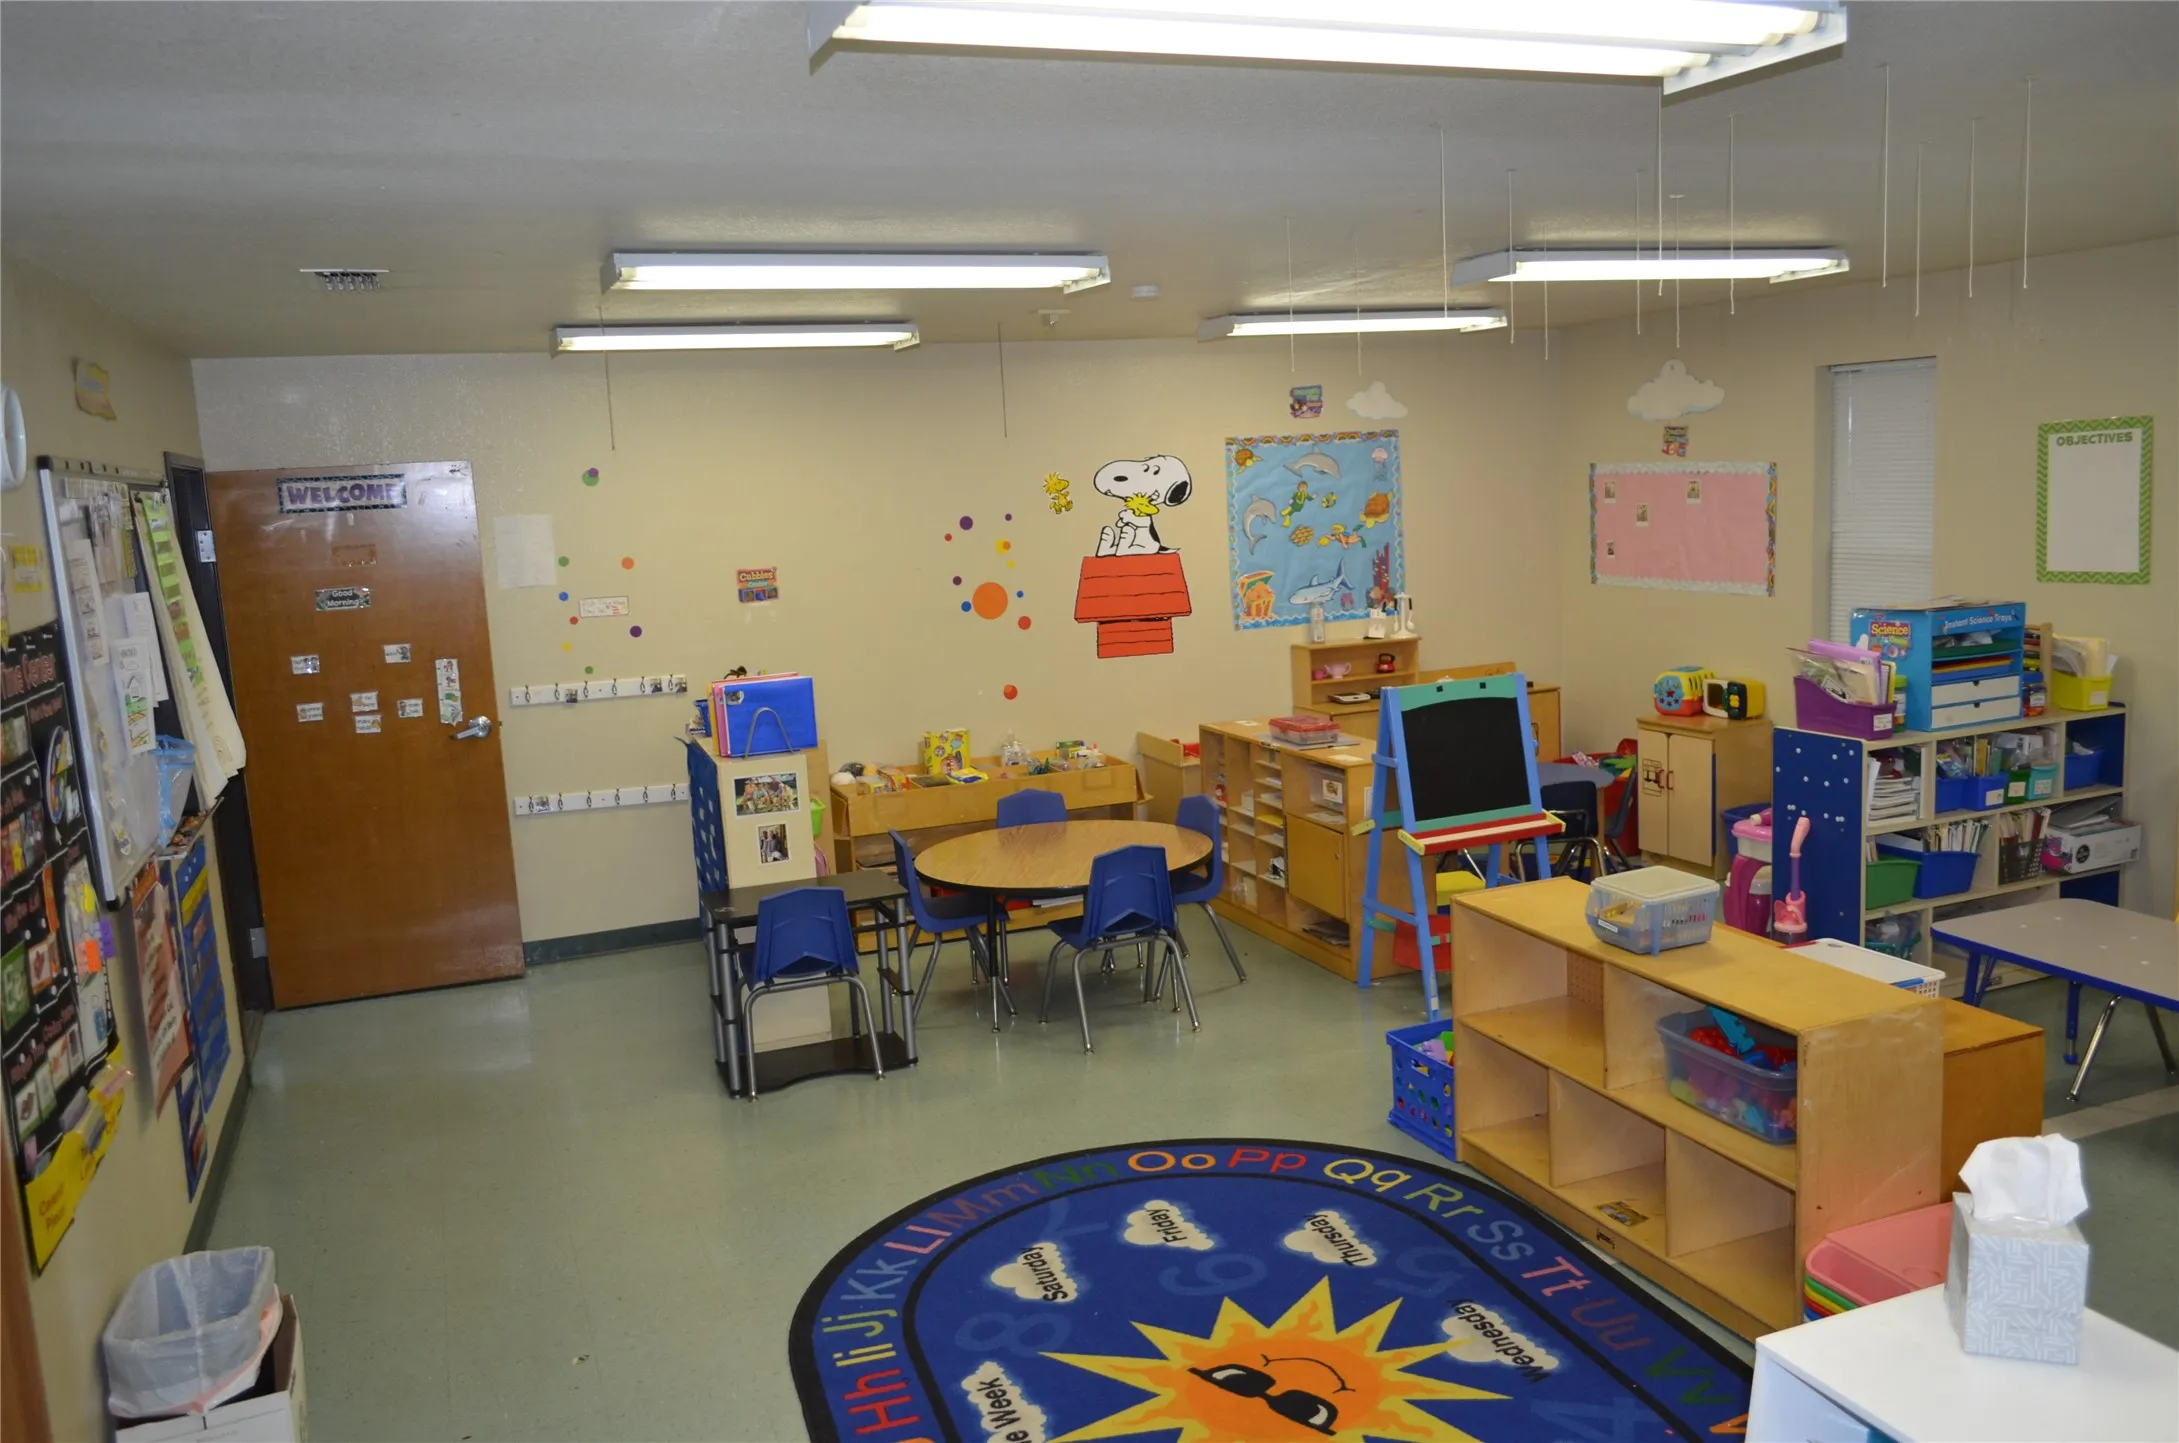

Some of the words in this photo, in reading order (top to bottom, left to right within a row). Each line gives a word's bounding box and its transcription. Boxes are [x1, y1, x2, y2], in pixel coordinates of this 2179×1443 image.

[2056, 432, 2133, 446] OBJECTIVES
[286, 483, 397, 505] WELCOME
[331, 589, 353, 598] Good
[740, 571, 774, 581] Cubbies
[326, 598, 360, 608] Morning
[1871, 623, 1909, 636] Science
[1944, 619, 1968, 629] Instant
[1969, 615, 1994, 625] Science
[1994, 613, 2012, 624] Trays
[1033, 1164, 1119, 1190] Nn
[1127, 1151, 1216, 1172] Oo
[1228, 1148, 1308, 1172] Pp
[1323, 1158, 1412, 1193] Qq
[926, 1181, 1040, 1229] Mm
[1403, 1183, 1484, 1218] Rr
[1146, 1208, 1188, 1243] Friday
[1304, 1213, 1369, 1266] Thursday
[1466, 1220, 1534, 1261] Ss
[840, 1258, 919, 1300] Kk
[1021, 1246, 1069, 1302] Saturday
[1521, 1256, 1592, 1297] Tt
[821, 1309, 898, 1338] Jj
[1446, 1298, 1552, 1383] Wednesday
[1570, 1297, 1653, 1351] Uu
[1644, 1347, 1735, 1404] Vv
[844, 1368, 920, 1435] Hh
[977, 1376, 1022, 1430] Week
